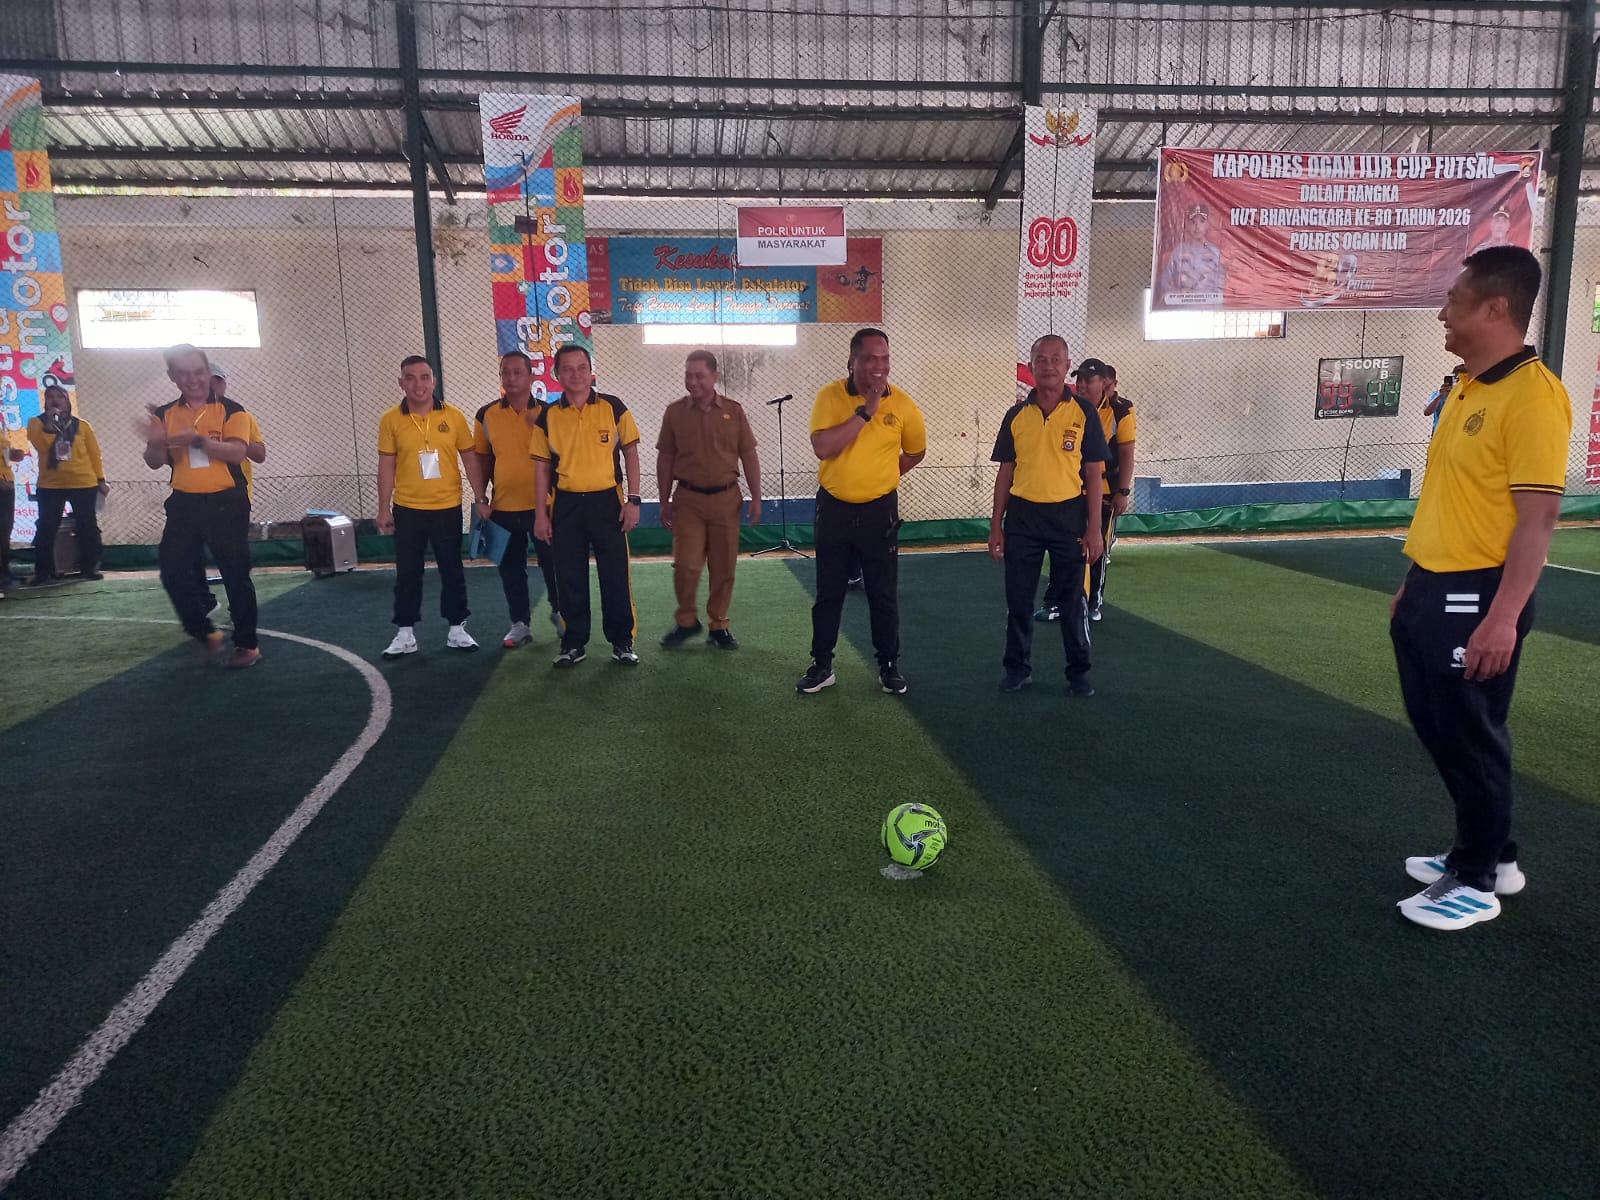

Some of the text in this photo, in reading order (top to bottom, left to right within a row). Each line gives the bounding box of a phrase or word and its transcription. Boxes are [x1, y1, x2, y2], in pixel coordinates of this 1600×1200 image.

[491, 133, 529, 141] HONDA
[1212, 153, 1497, 180] KAPOLRES OGAN ILIR CUP FUTSAL
[1300, 184, 1399, 203] DALAM RANGKA
[1230, 208, 1471, 226] HUT BHAYANGKARA KE-80 TAHUN 2026
[758, 226, 826, 236] POLRI UNTUK
[757, 239, 827, 250] MASYARAKAT
[1026, 216, 1078, 268] 80
[1289, 231, 1408, 251] POLRES OGAN ILIR
[588, 243, 605, 257] AS
[2, 200, 49, 354] motor
[618, 277, 660, 292] Tidak
[663, 277, 692, 292] Bisa
[742, 277, 809, 293] Eskalator
[1380, 369, 1389, 380] B
